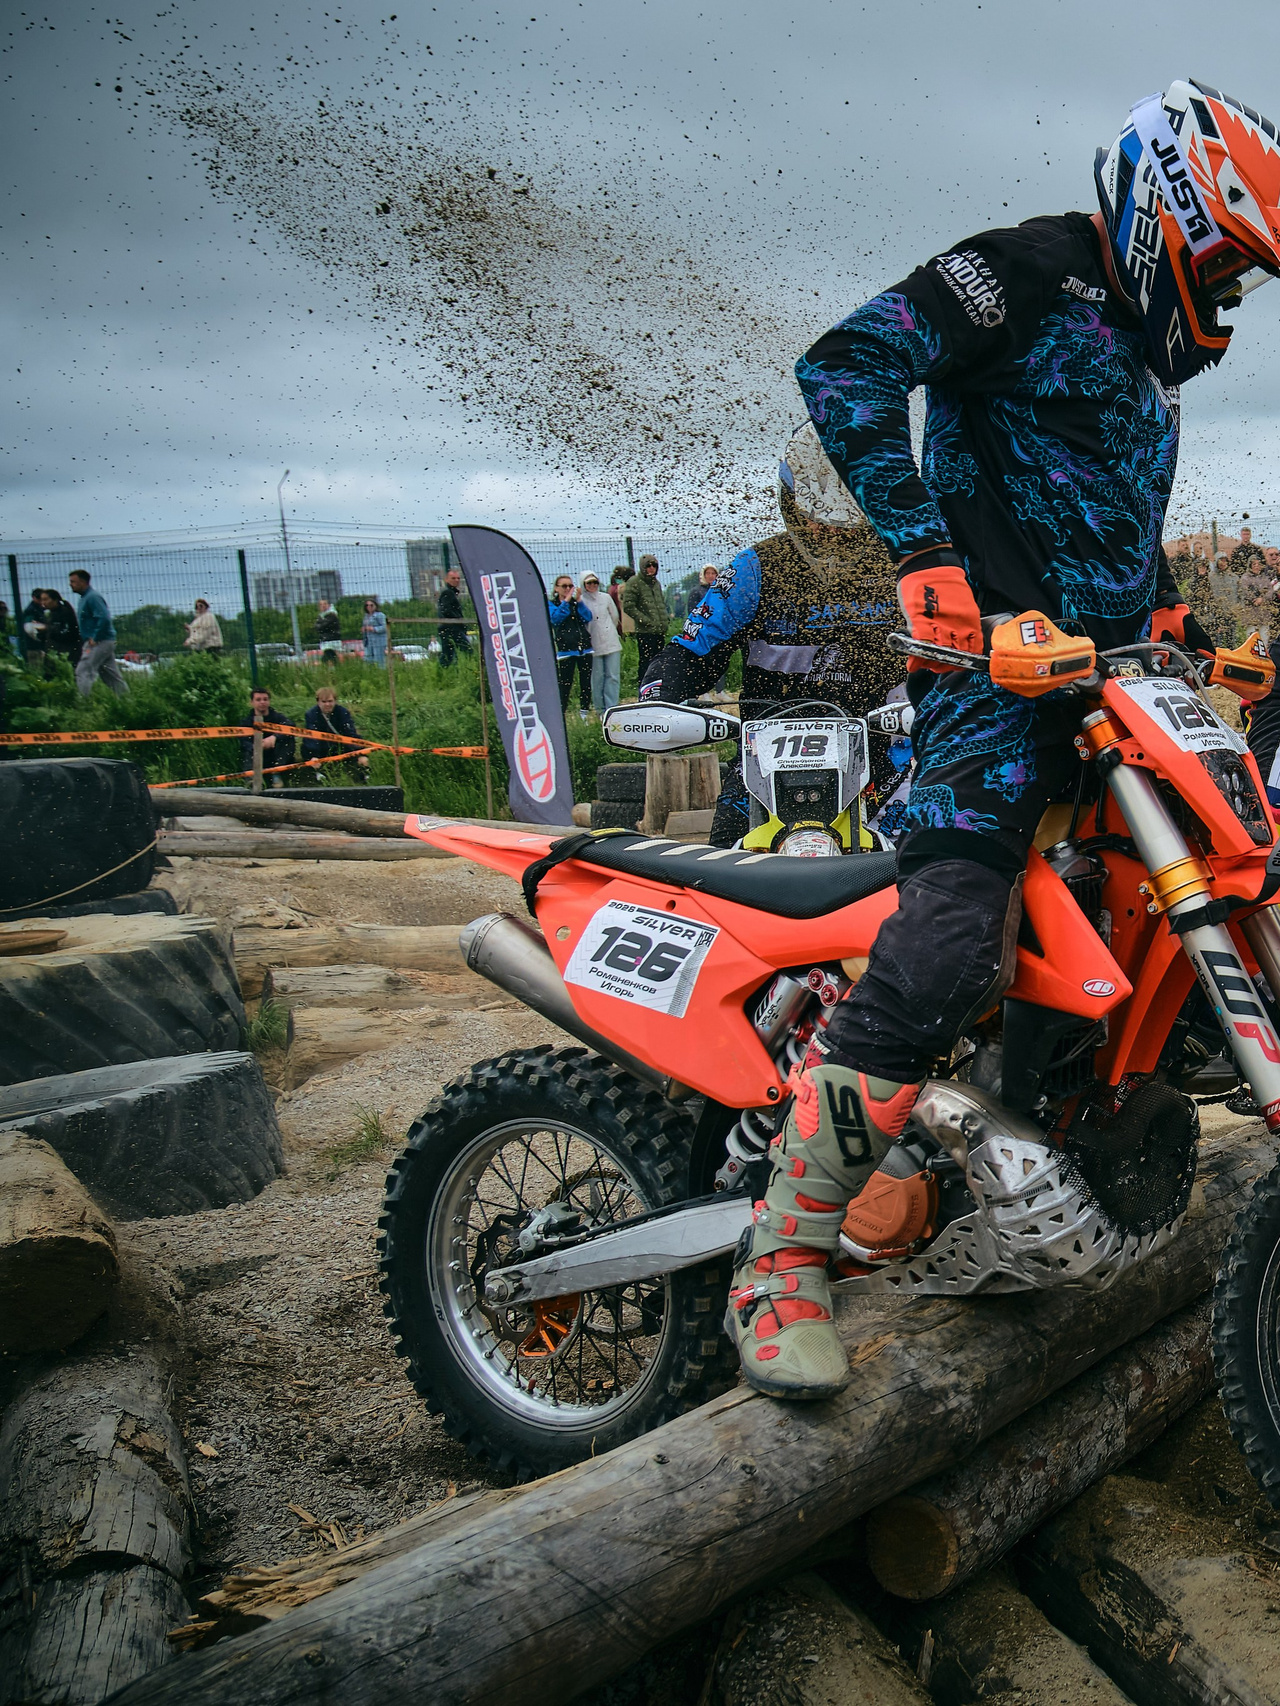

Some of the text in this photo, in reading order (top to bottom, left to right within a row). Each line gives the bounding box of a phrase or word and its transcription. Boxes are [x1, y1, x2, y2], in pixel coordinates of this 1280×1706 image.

[963, 300, 982, 326] TEAM
[1153, 695, 1219, 731] 126
[771, 735, 829, 759] 118
[608, 901, 636, 913] 2026
[590, 926, 692, 982] 126
[589, 966, 657, 995] Романенков
[600, 980, 635, 999] Игорь
